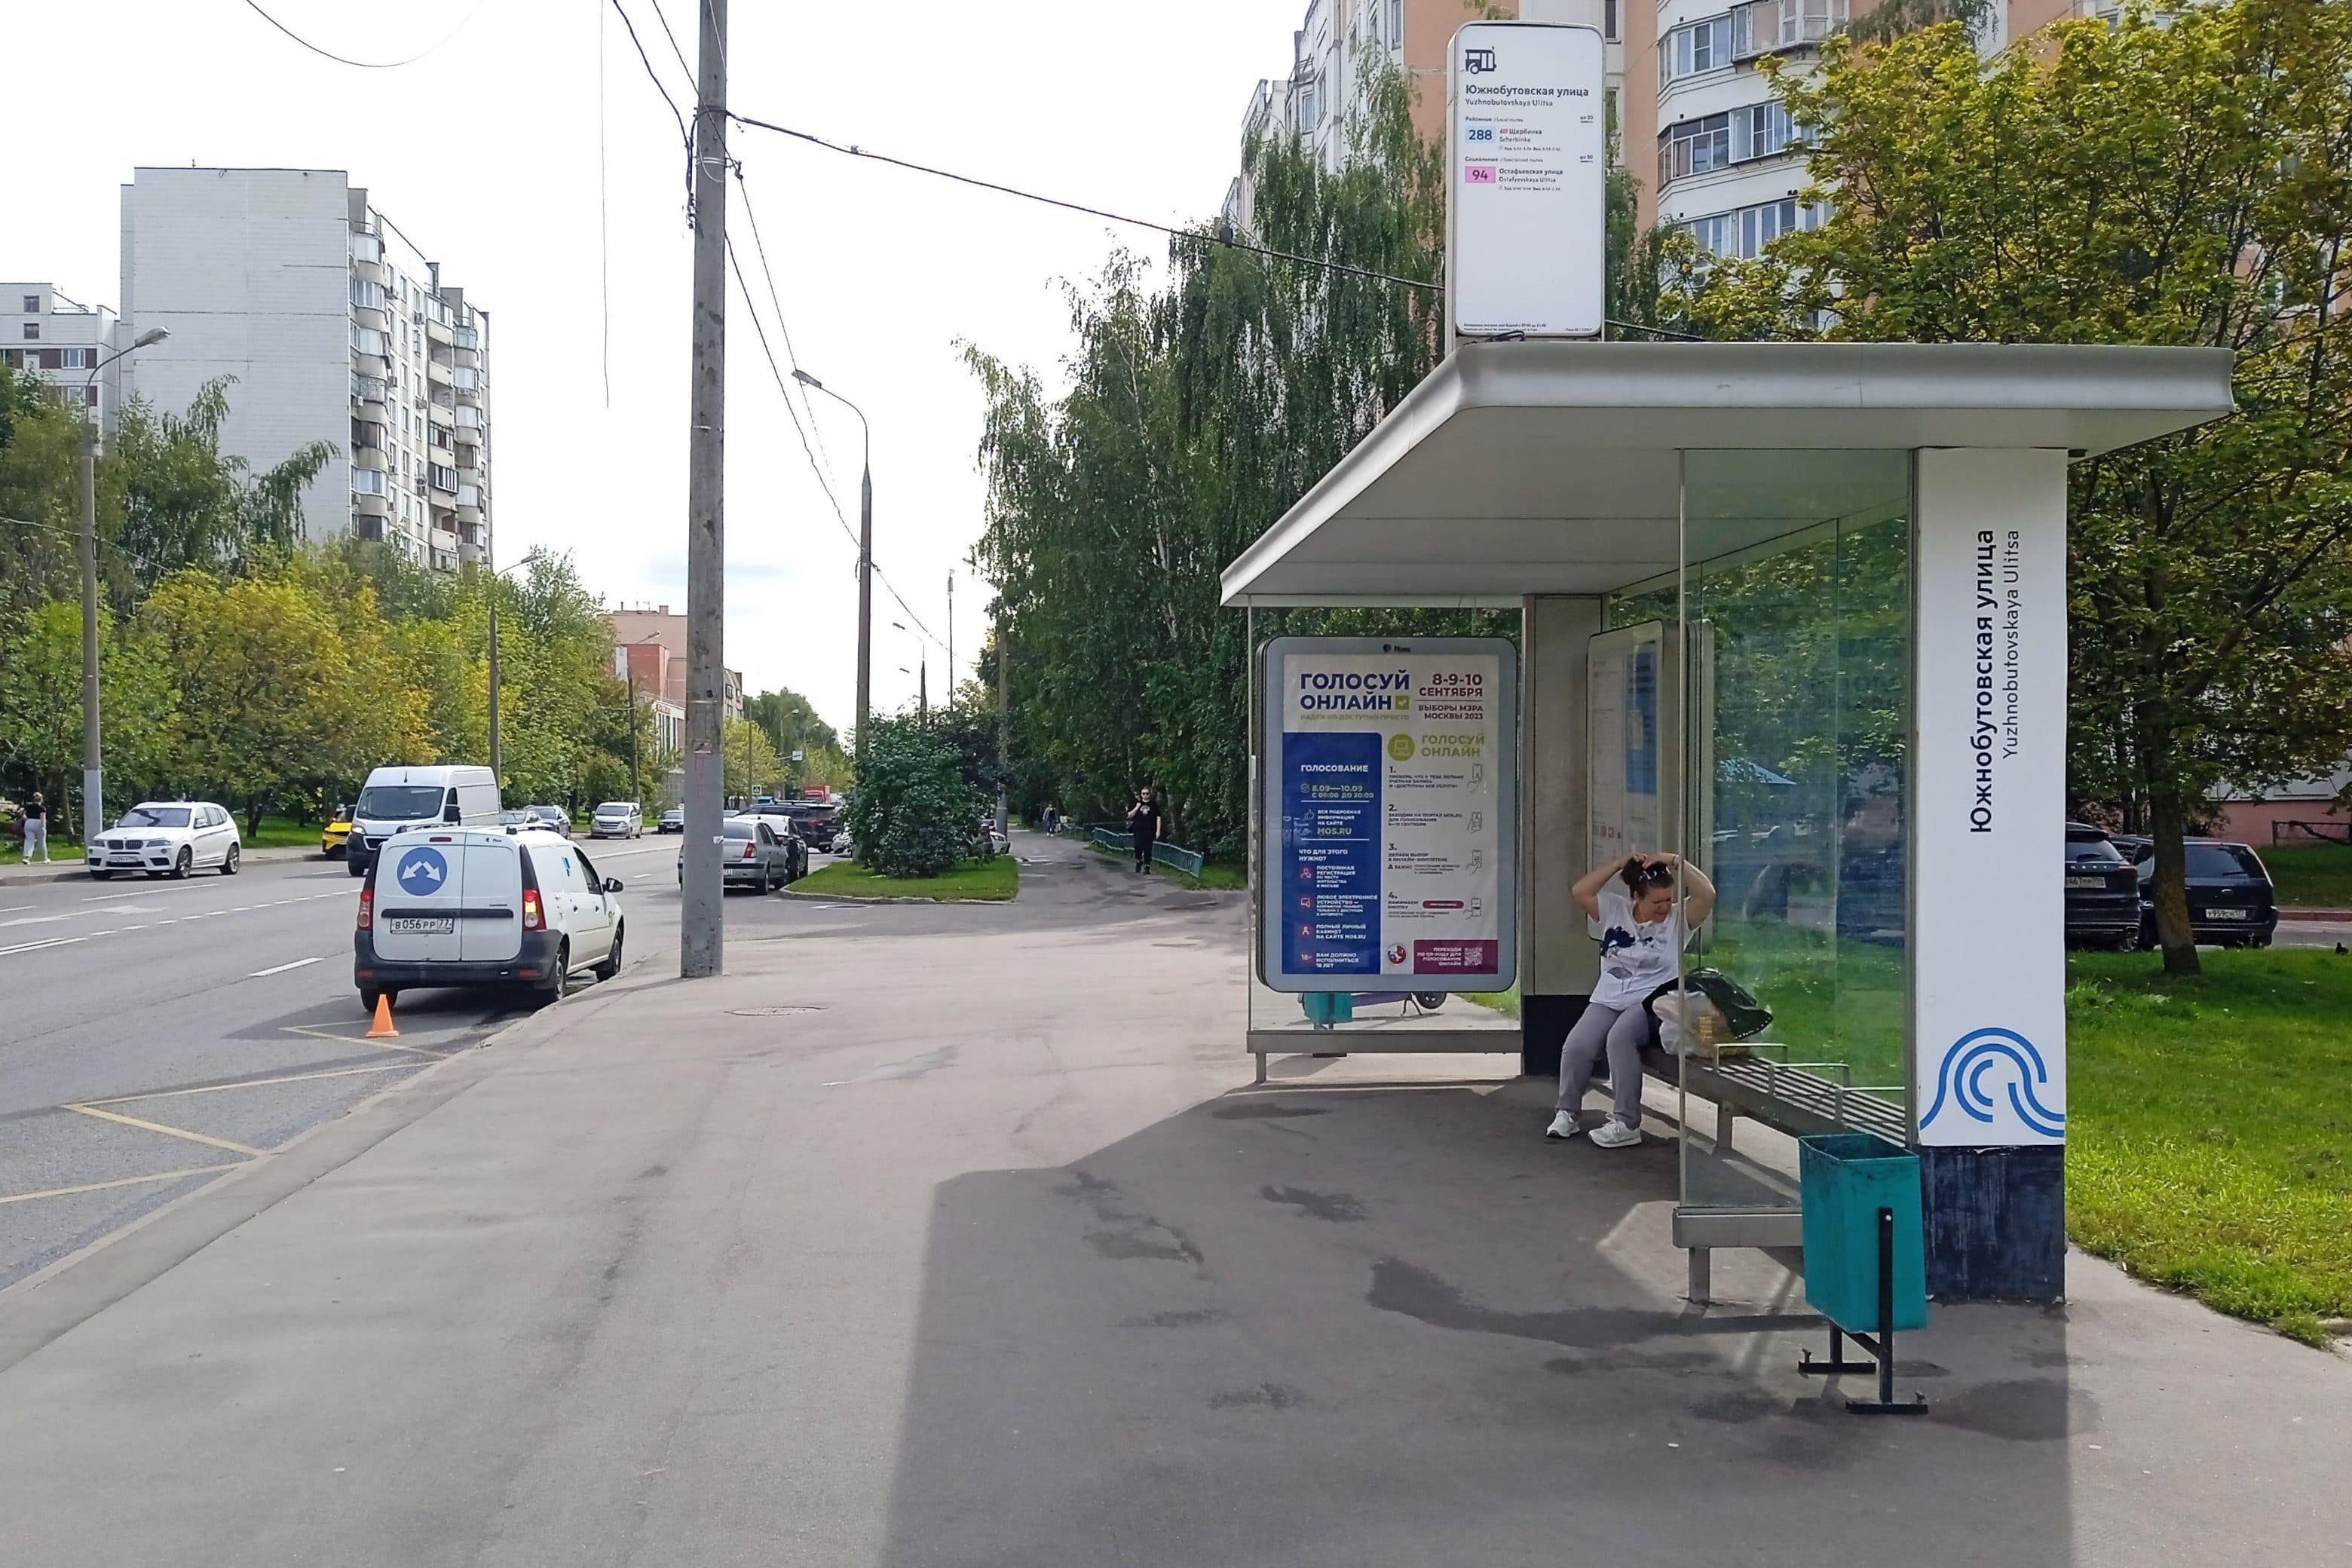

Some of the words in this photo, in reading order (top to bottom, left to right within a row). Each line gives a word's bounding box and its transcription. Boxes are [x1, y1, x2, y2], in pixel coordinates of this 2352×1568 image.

[1465, 84, 1554, 96] Южнобутовская
[1557, 87, 1589, 97] улица
[1465, 98, 1530, 106] Yuzhnobutovskaya
[1468, 130, 1493, 140] 288
[1472, 170, 1488, 180] 94
[2002, 531, 2019, 583] Ulitsa
[1977, 530, 1998, 610] улица
[1300, 669, 1410, 690] ГОЛОСУЙ
[1432, 673, 1483, 685] 8-9-10
[2002, 590, 2022, 759] Yuzhnobutovskaya
[1419, 688, 1483, 697] СЕНТЯБРЯ
[1300, 691, 1392, 710] ОНЛАЙН
[1970, 617, 1998, 832] Южнобутовская
[1422, 733, 1484, 744] ГОЛОСУЙ
[1422, 746, 1480, 757] ОНЛАЙН
